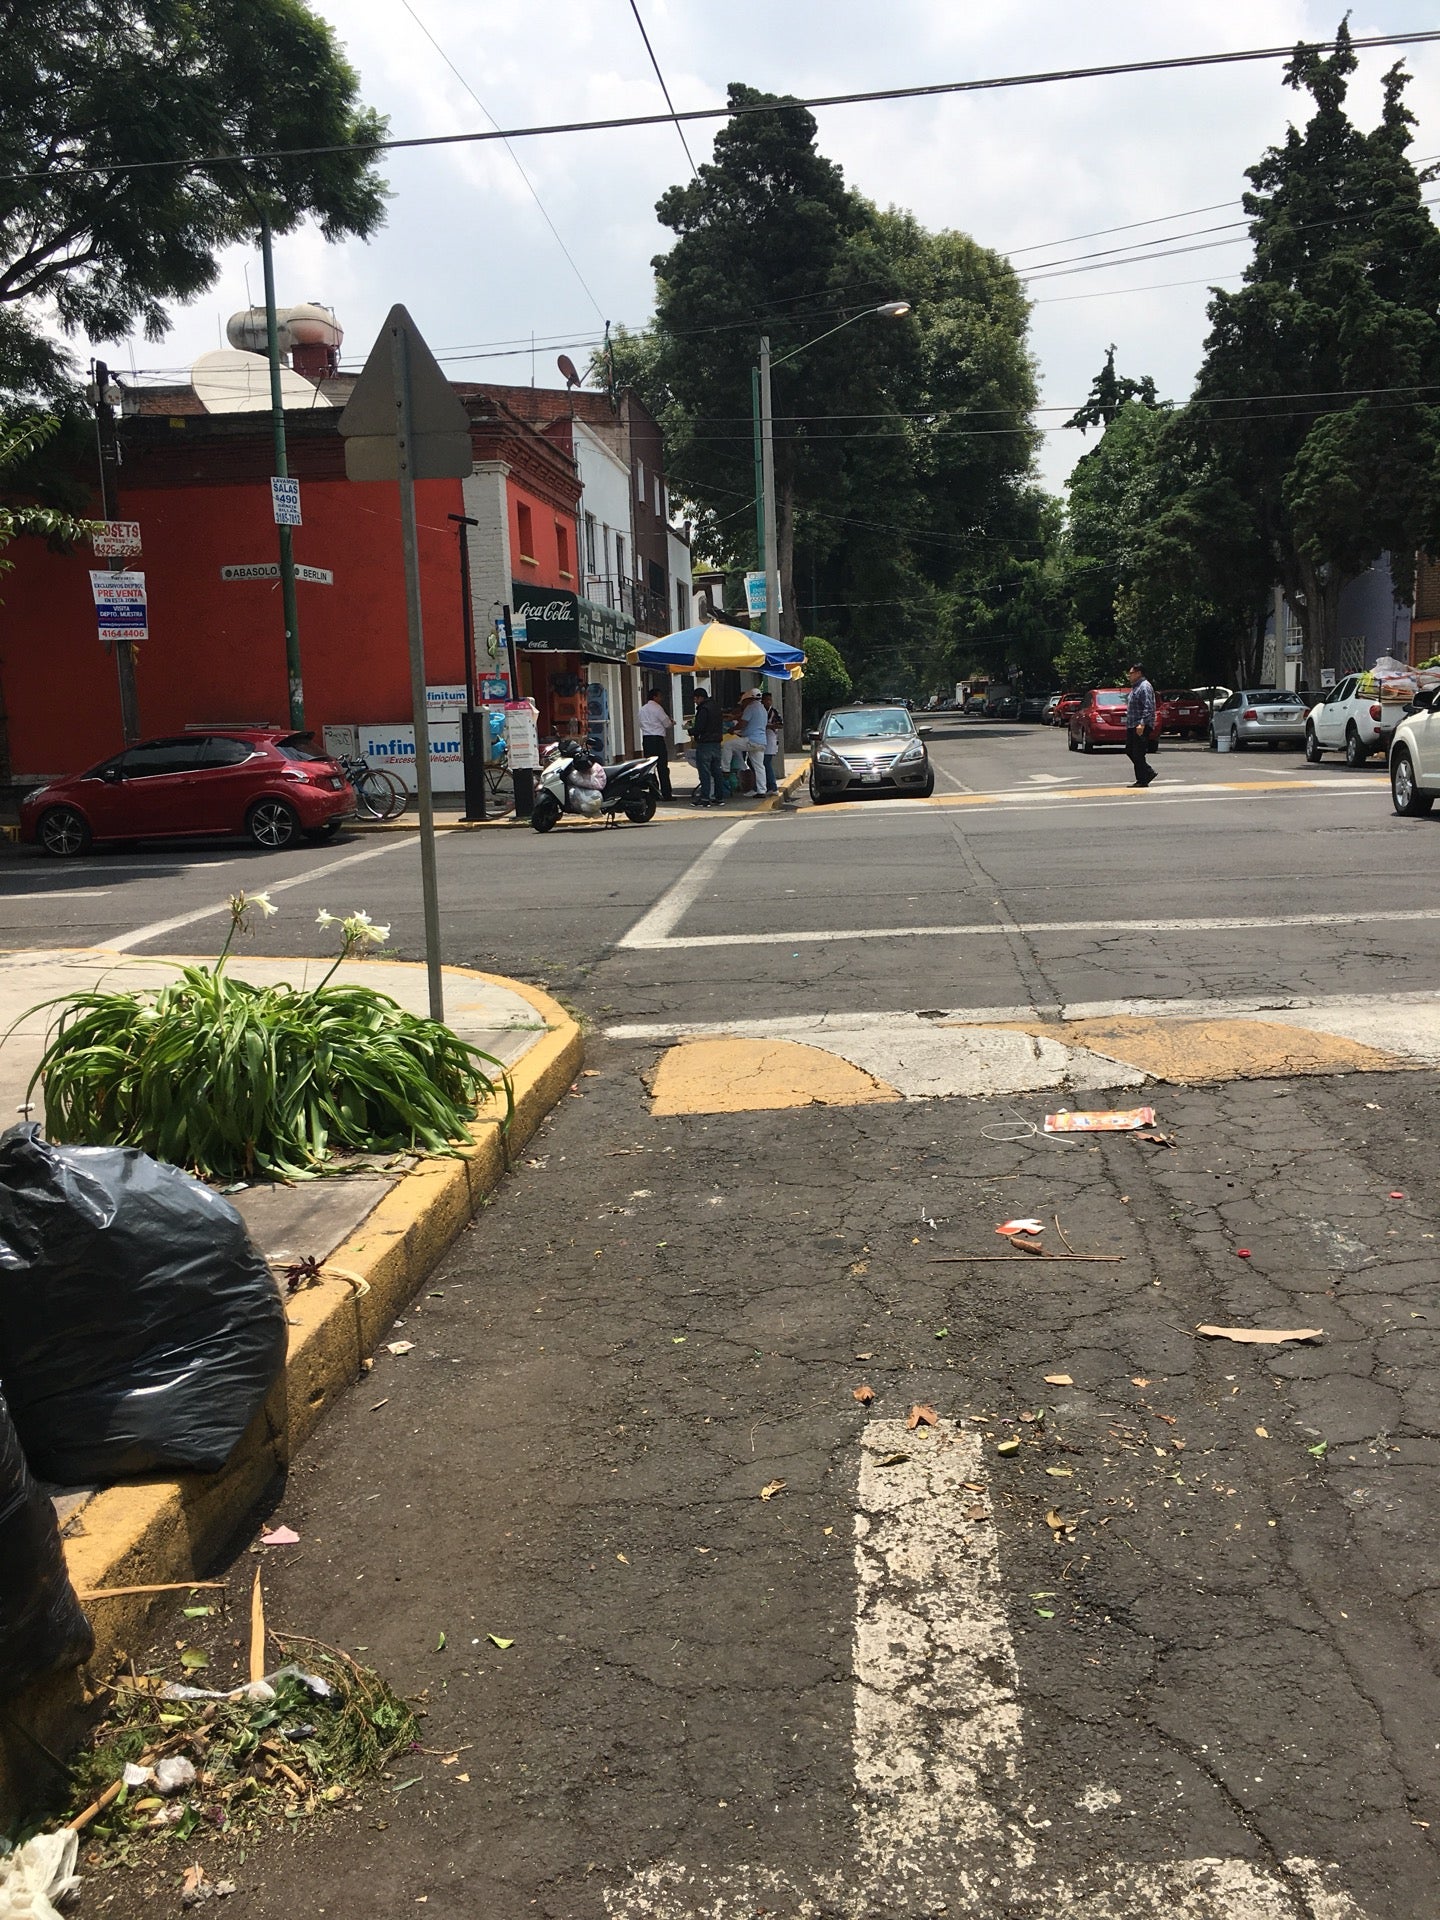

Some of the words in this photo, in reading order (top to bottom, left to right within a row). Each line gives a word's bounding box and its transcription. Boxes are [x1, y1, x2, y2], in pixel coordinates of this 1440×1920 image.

[273, 483, 298, 494] SALAS
[275, 494, 298, 504] $490
[92, 524, 139, 538] LOSETS
[233, 566, 278, 578] ABASOLO
[303, 568, 328, 581] BERLIN
[97, 589, 114, 598] PRE
[115, 589, 144, 598] VENTA
[102, 629, 122, 638] 4164
[123, 629, 145, 638] 4406
[427, 691, 466, 701] finitum
[368, 740, 461, 756] infinum
[389, 756, 416, 764] Exceso
